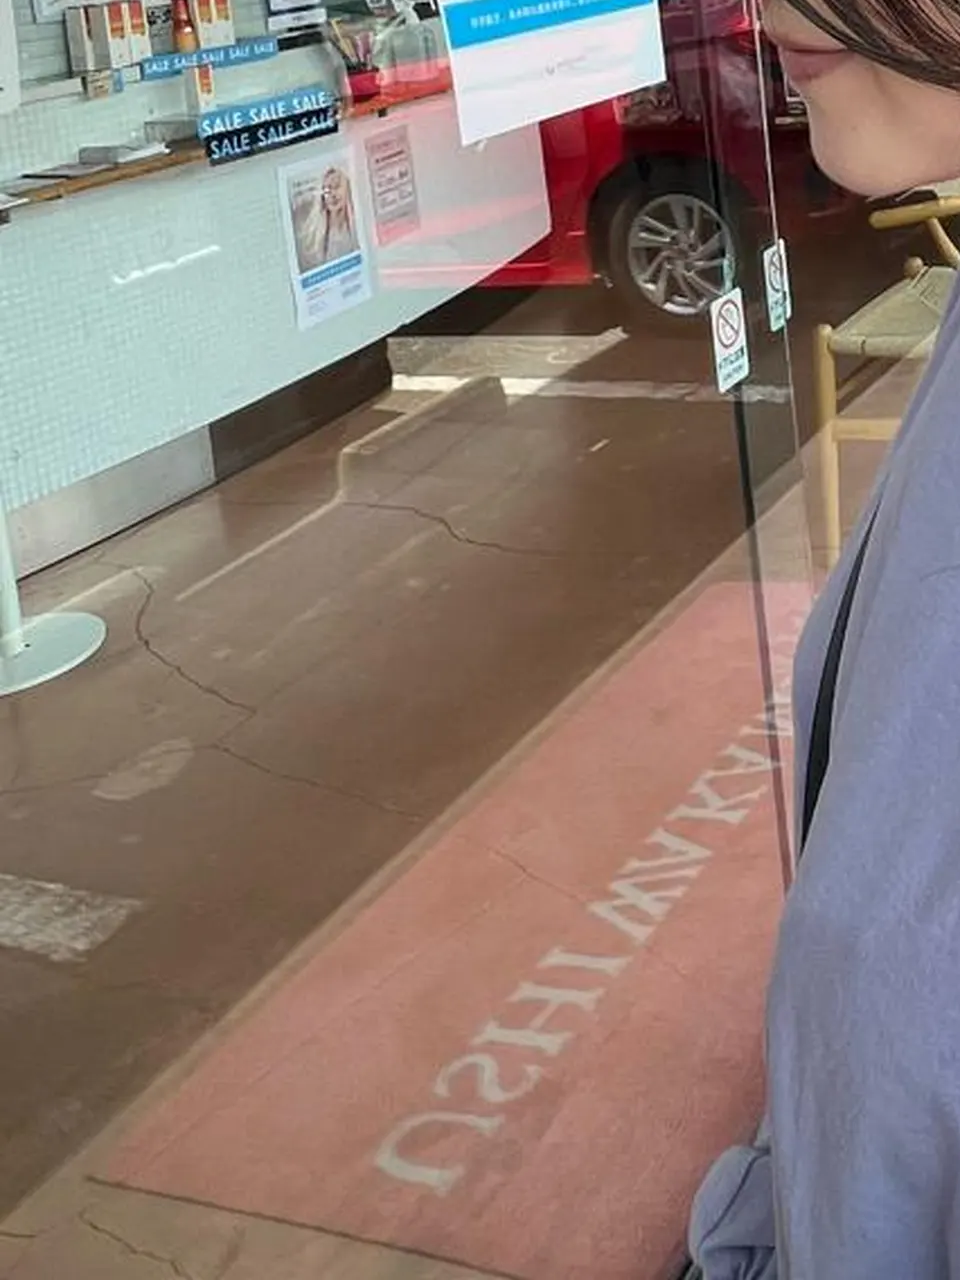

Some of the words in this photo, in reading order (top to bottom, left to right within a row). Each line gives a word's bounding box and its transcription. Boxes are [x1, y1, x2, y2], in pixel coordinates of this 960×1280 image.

[144, 59, 170, 73] SALE
[174, 54, 198, 69] SALE
[202, 50, 225, 64] SALE
[229, 44, 250, 58] SALE
[253, 41, 275, 54] SALE
[201, 111, 244, 137] SALE
[249, 101, 288, 125] SALE
[292, 91, 328, 113] SALE
[210, 134, 251, 160] SALE
[256, 121, 294, 147] SALE
[300, 111, 335, 134] SALE
